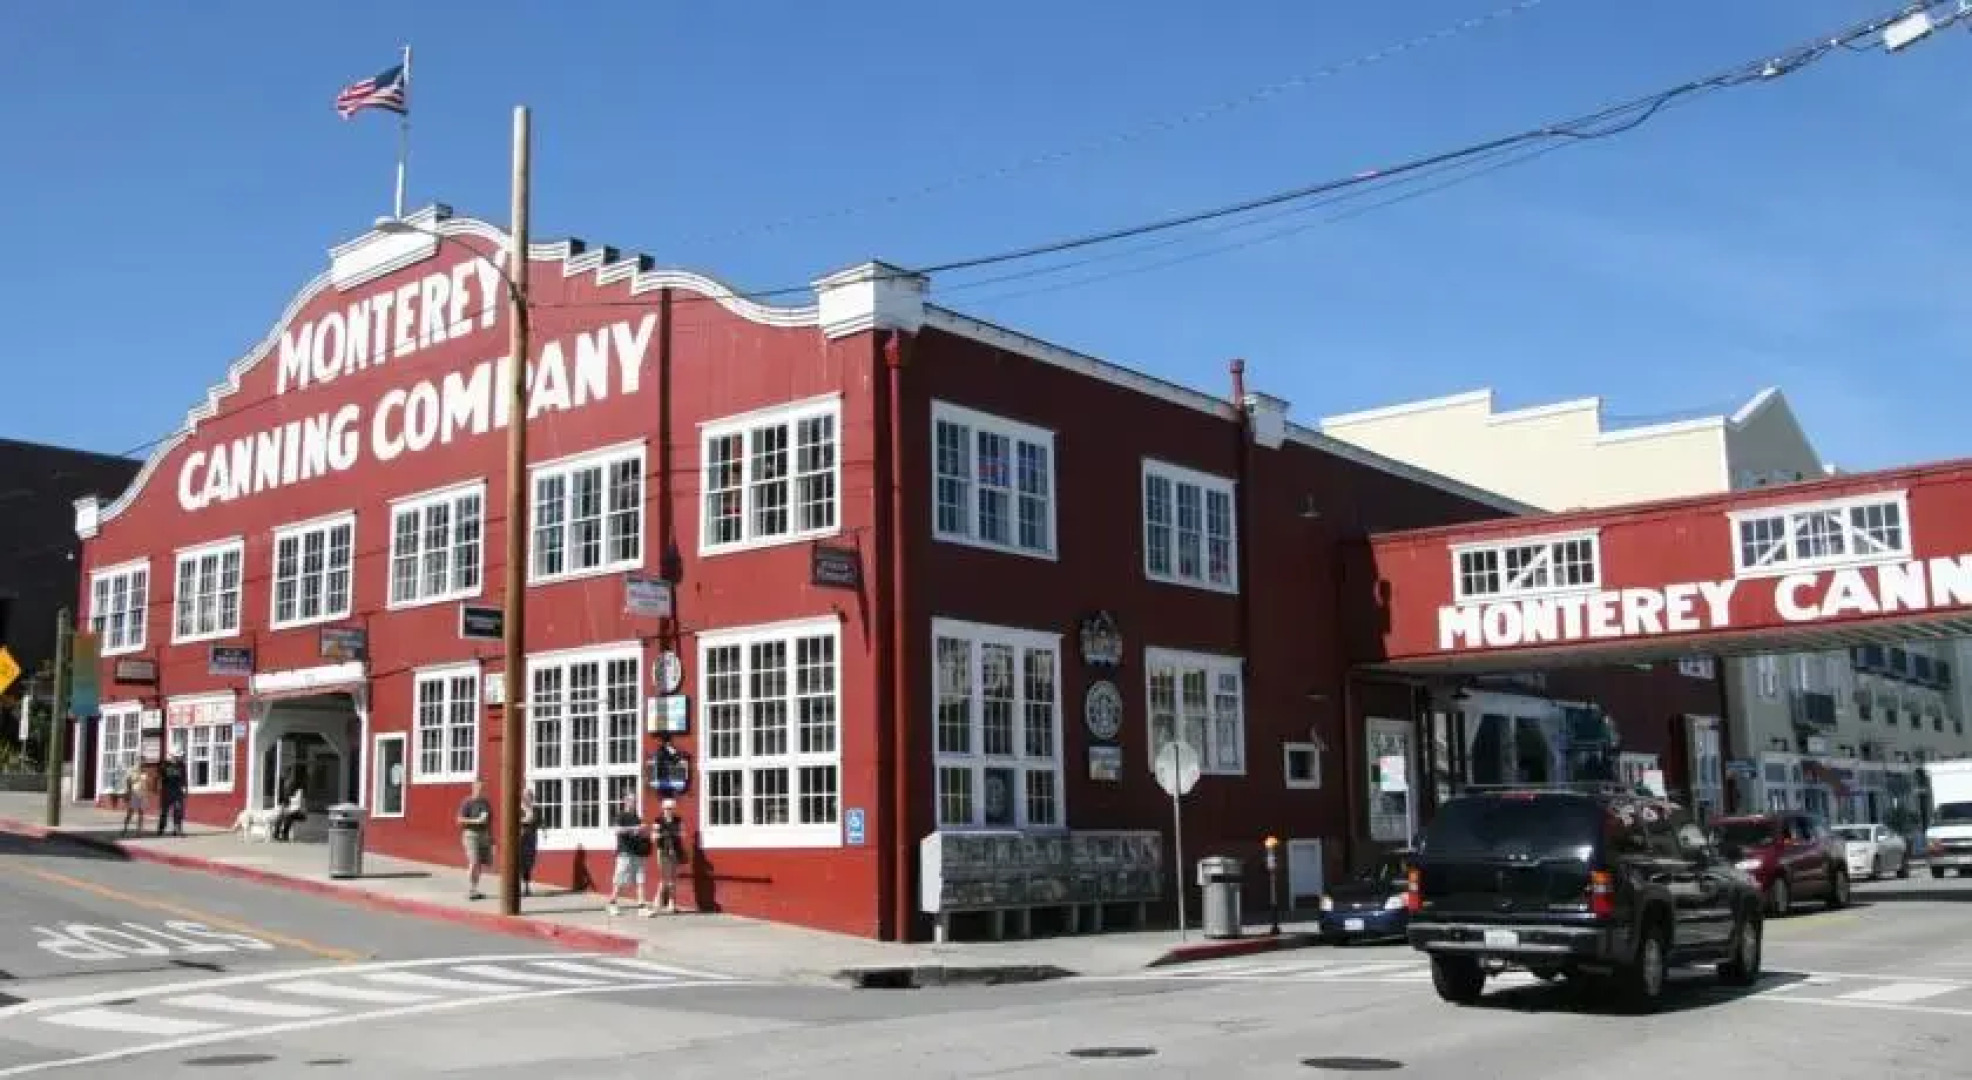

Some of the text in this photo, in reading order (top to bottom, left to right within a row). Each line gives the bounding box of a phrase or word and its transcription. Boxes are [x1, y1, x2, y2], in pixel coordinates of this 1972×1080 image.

[276, 256, 500, 395] MONTEREY
[178, 403, 360, 512] CANNING
[1438, 553, 1972, 649] MONTEREY CANN
[32, 920, 276, 959] STOP
